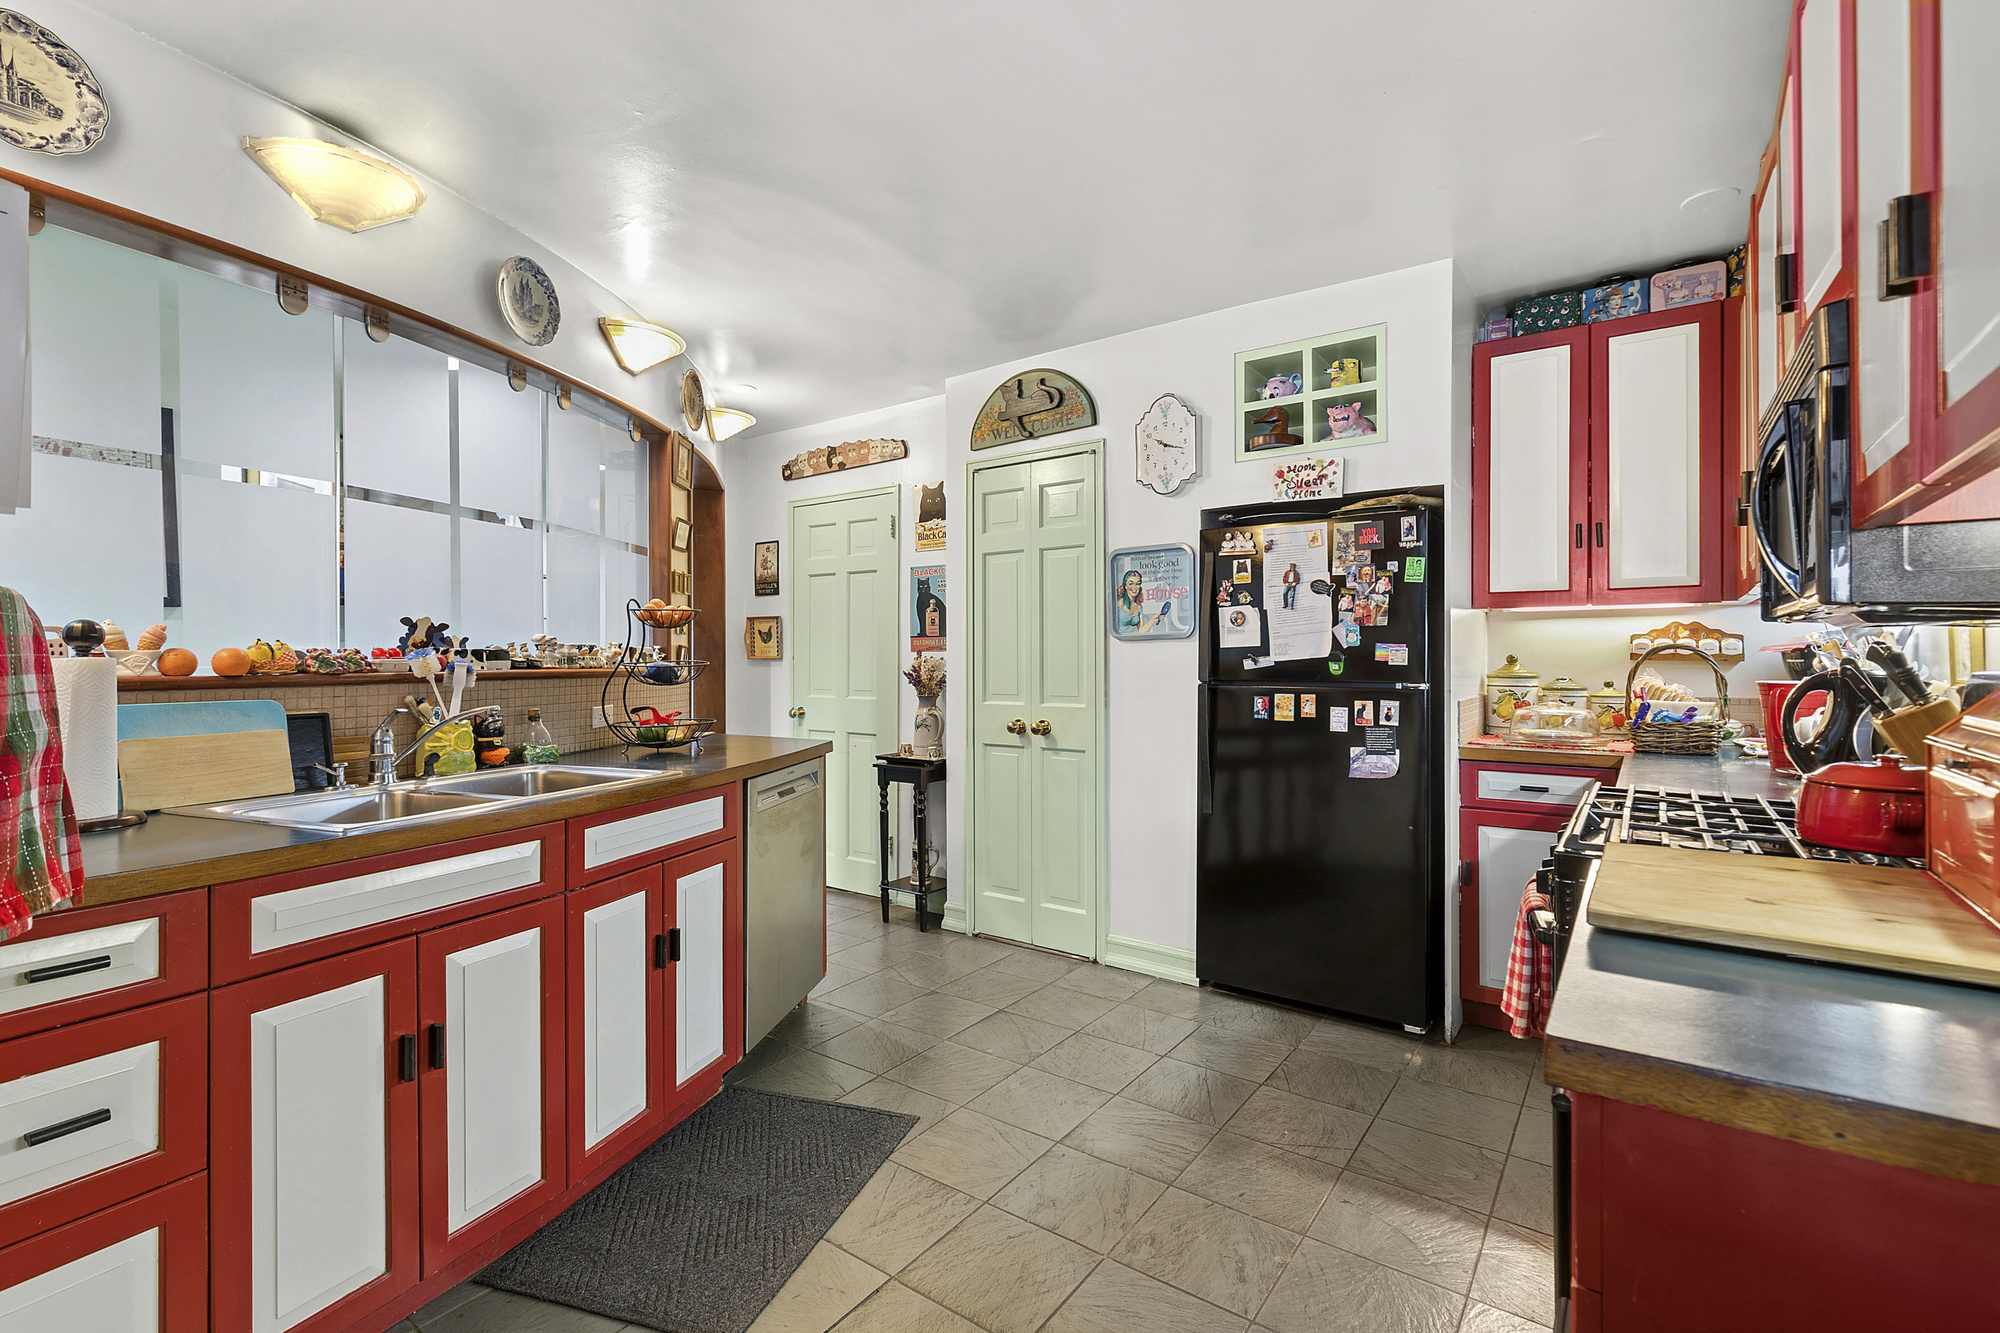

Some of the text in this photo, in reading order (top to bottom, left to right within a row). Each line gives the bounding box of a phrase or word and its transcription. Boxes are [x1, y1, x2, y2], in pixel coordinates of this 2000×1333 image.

[991, 416, 1075, 441] WELCOME
[1145, 453, 1150, 462] 8
[917, 531, 938, 541] Black
[1361, 527, 1377, 536] YOU
[1358, 534, 1382, 544] ROCK.
[1139, 558, 1179, 570] look good
[914, 568, 939, 577] BLACK
